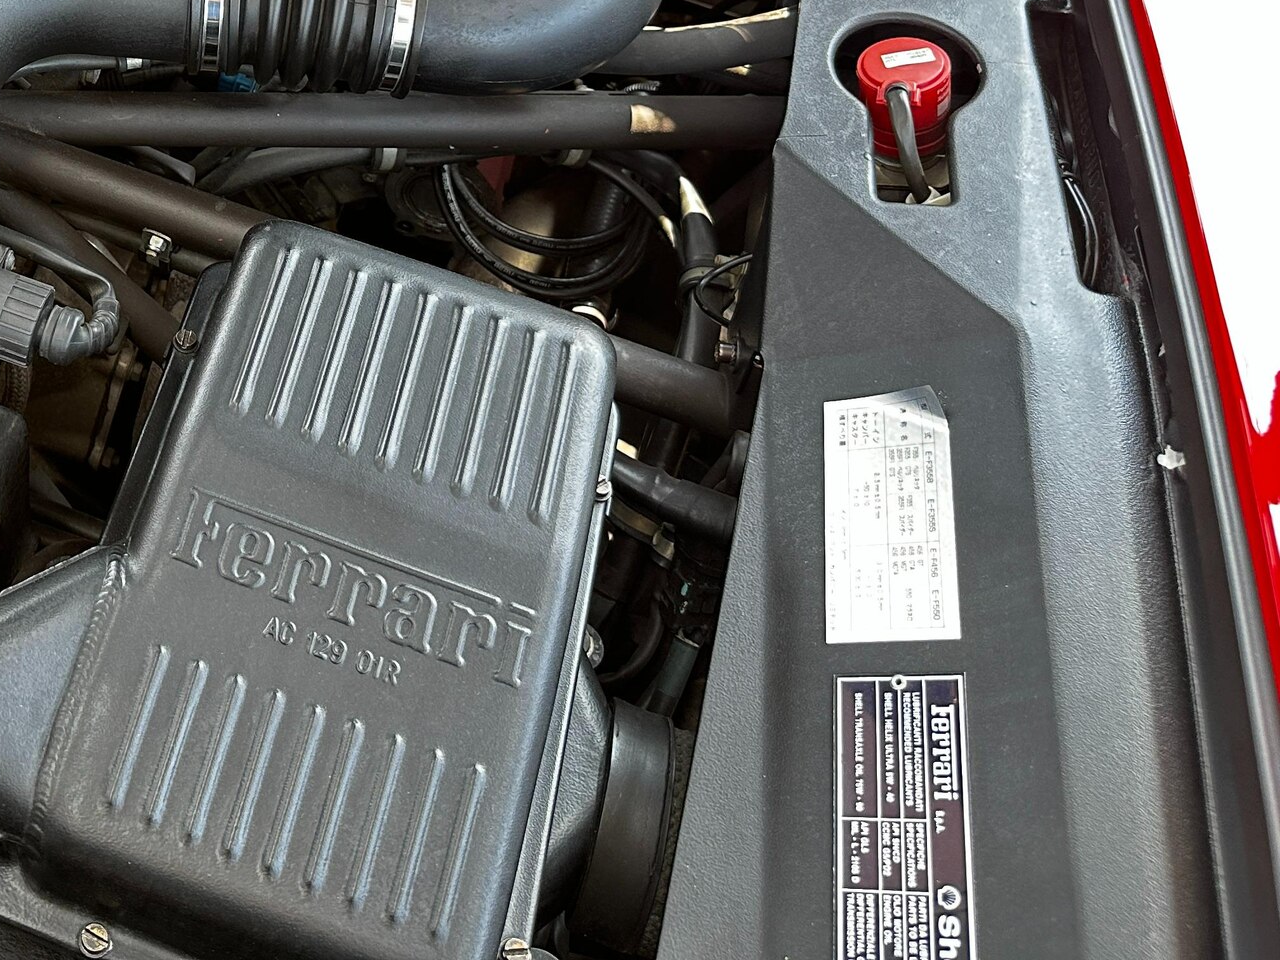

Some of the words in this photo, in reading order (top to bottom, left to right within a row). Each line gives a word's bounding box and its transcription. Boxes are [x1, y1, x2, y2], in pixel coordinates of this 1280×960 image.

[170, 486, 536, 688] Ferrari
[263, 616, 298, 645] AC
[308, 631, 348, 665] 129
[355, 649, 402, 686] 01R
[853, 692, 863, 716] SHELL
[883, 692, 892, 717] SHELL
[911, 692, 921, 745] LUBRIFICANTI
[853, 718, 863, 761] TRANSAXLE
[884, 719, 893, 741] HELIX
[901, 692, 912, 752] RECOMMENDED
[854, 763, 863, 776] OIL
[884, 744, 894, 769] ULTRA
[930, 704, 958, 800] Ferrari
[903, 755, 913, 806] LUBRICANTS
[912, 747, 924, 812] RACCOMANDATI
[860, 821, 868, 835] API
[891, 822, 899, 835] API
[905, 822, 916, 887] SPECIFICATIONS
[915, 822, 925, 870] SPECIFICHE
[855, 893, 865, 953] DIFFERENTIAL
[882, 895, 892, 926] ENGINE
[892, 895, 901, 916] OLIO
[907, 895, 917, 924] PARTS
[917, 896, 927, 922] PARTI
[844, 892, 856, 957] TRANSMISSION
[864, 893, 875, 960] DIFFERENZIALE
[883, 929, 892, 945] OIL
[892, 918, 902, 957] MOTORE
[908, 926, 917, 939] TO
[918, 924, 927, 937] DA
[937, 915, 962, 960] Sh
[908, 941, 918, 954] BE
